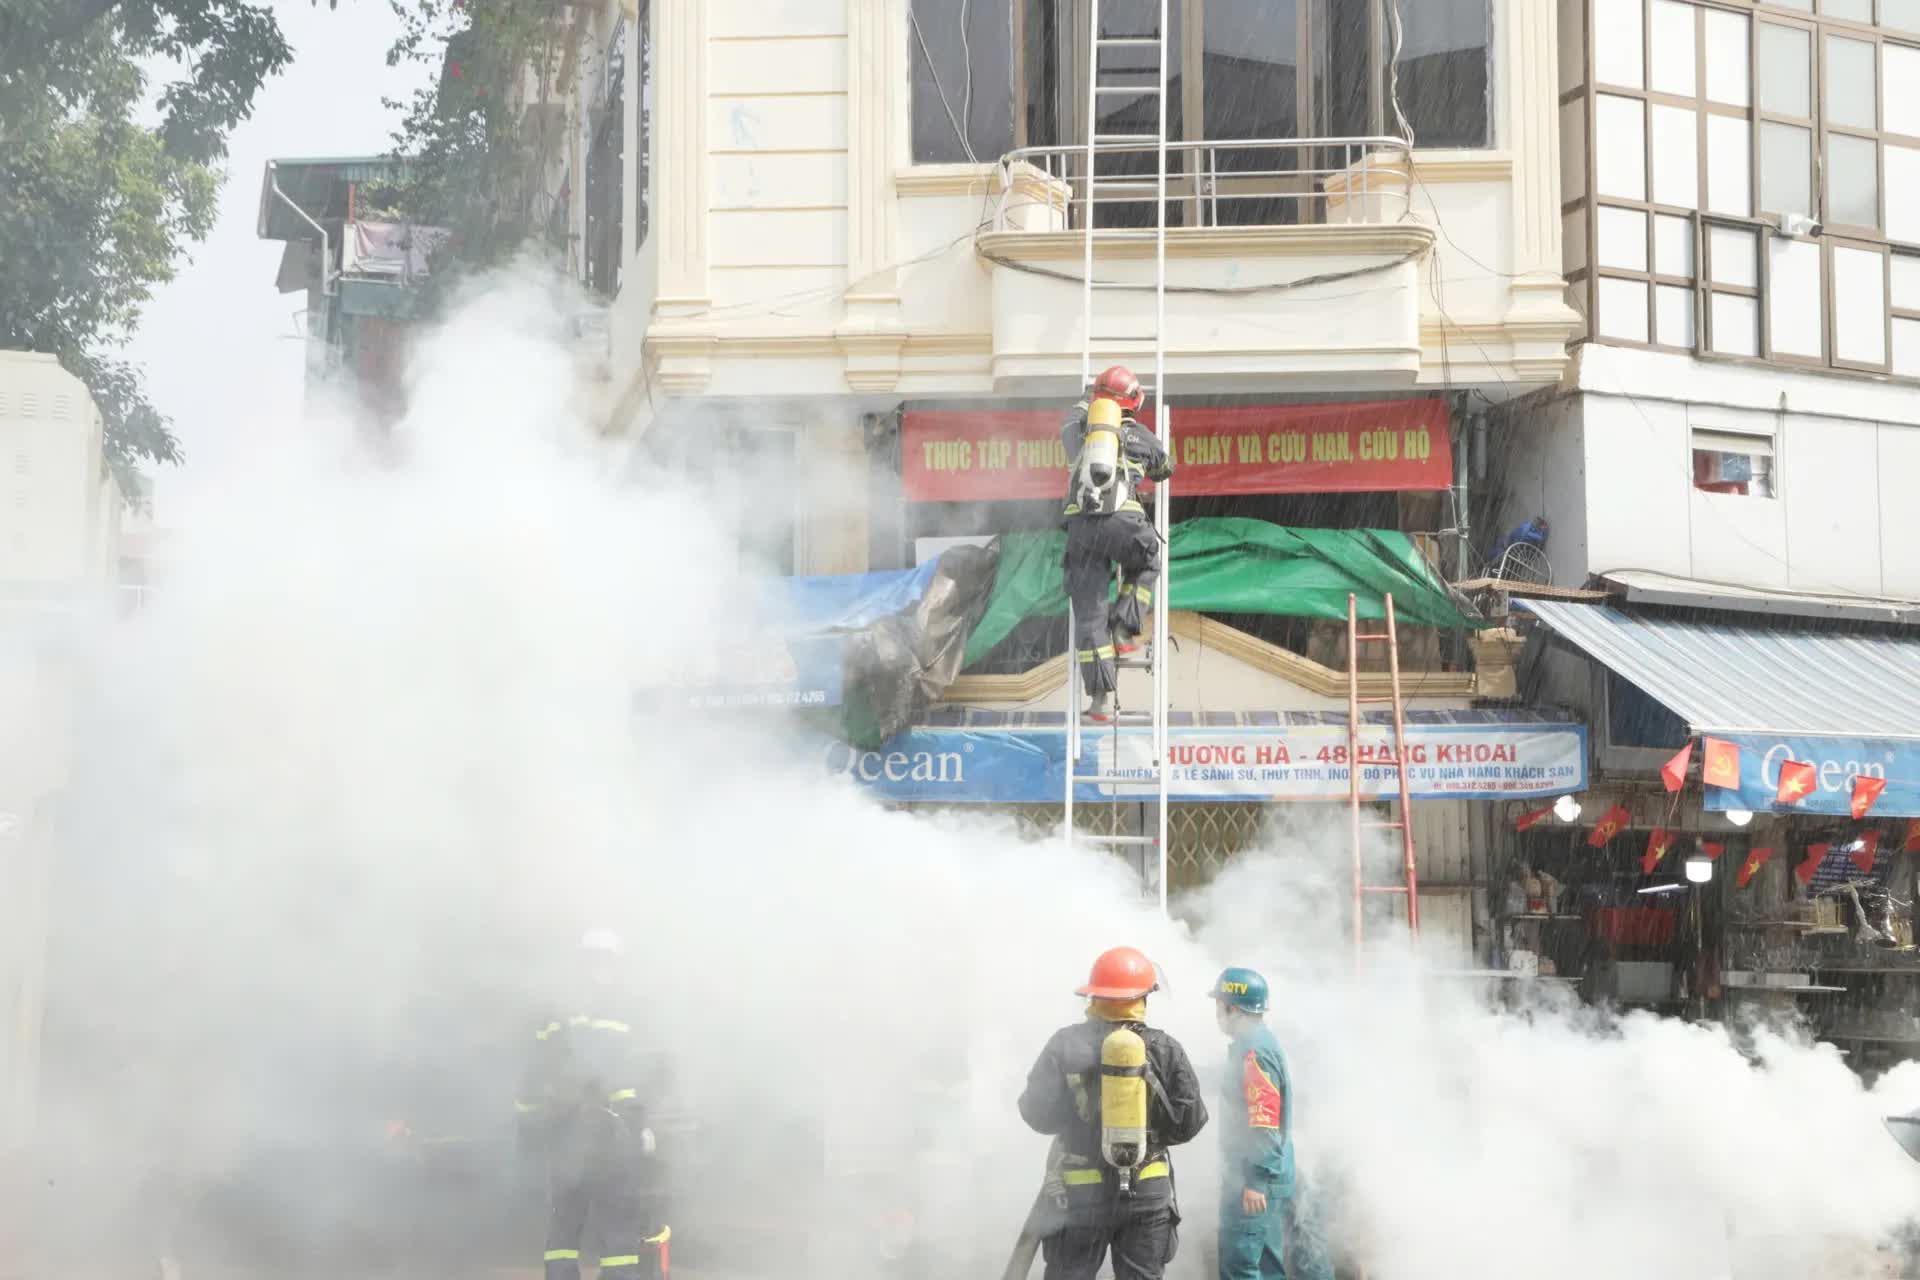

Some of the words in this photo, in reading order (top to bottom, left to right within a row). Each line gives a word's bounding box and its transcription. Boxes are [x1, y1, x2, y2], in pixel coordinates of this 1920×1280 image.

[1405, 425, 1431, 464] HỘ
[1255, 739, 1291, 765] HÀ
[1316, 745, 1348, 764] 48
[1436, 743, 1517, 763] KHOAI
[1384, 768, 1416, 780] PHC
